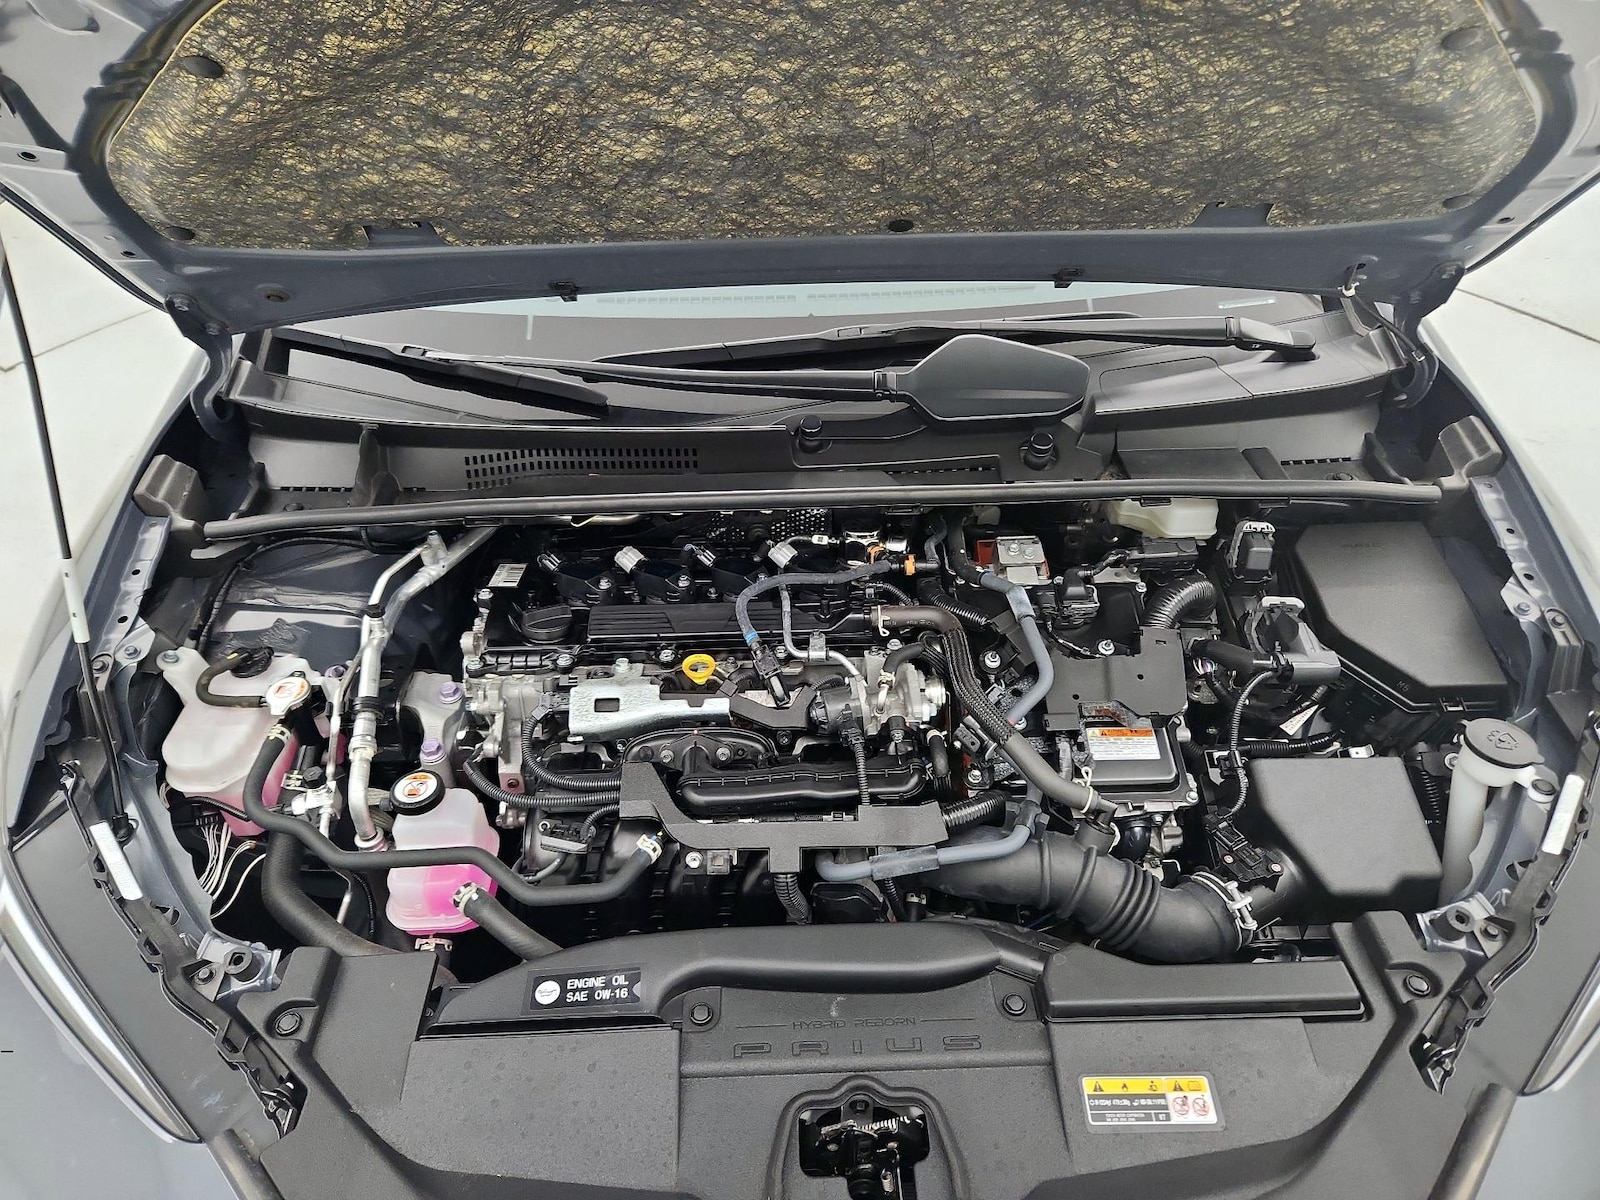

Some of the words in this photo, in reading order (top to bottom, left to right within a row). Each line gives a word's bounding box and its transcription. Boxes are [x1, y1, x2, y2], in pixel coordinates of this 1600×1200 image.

[567, 976, 606, 989] ENGINE
[612, 975, 629, 985] OIL
[566, 991, 588, 1002] SAE
[595, 988, 629, 1000] 0W-16
[792, 1020, 847, 1030] HYBRID
[854, 1017, 916, 1027] REBORN
[733, 1034, 982, 1059] PRIUS
